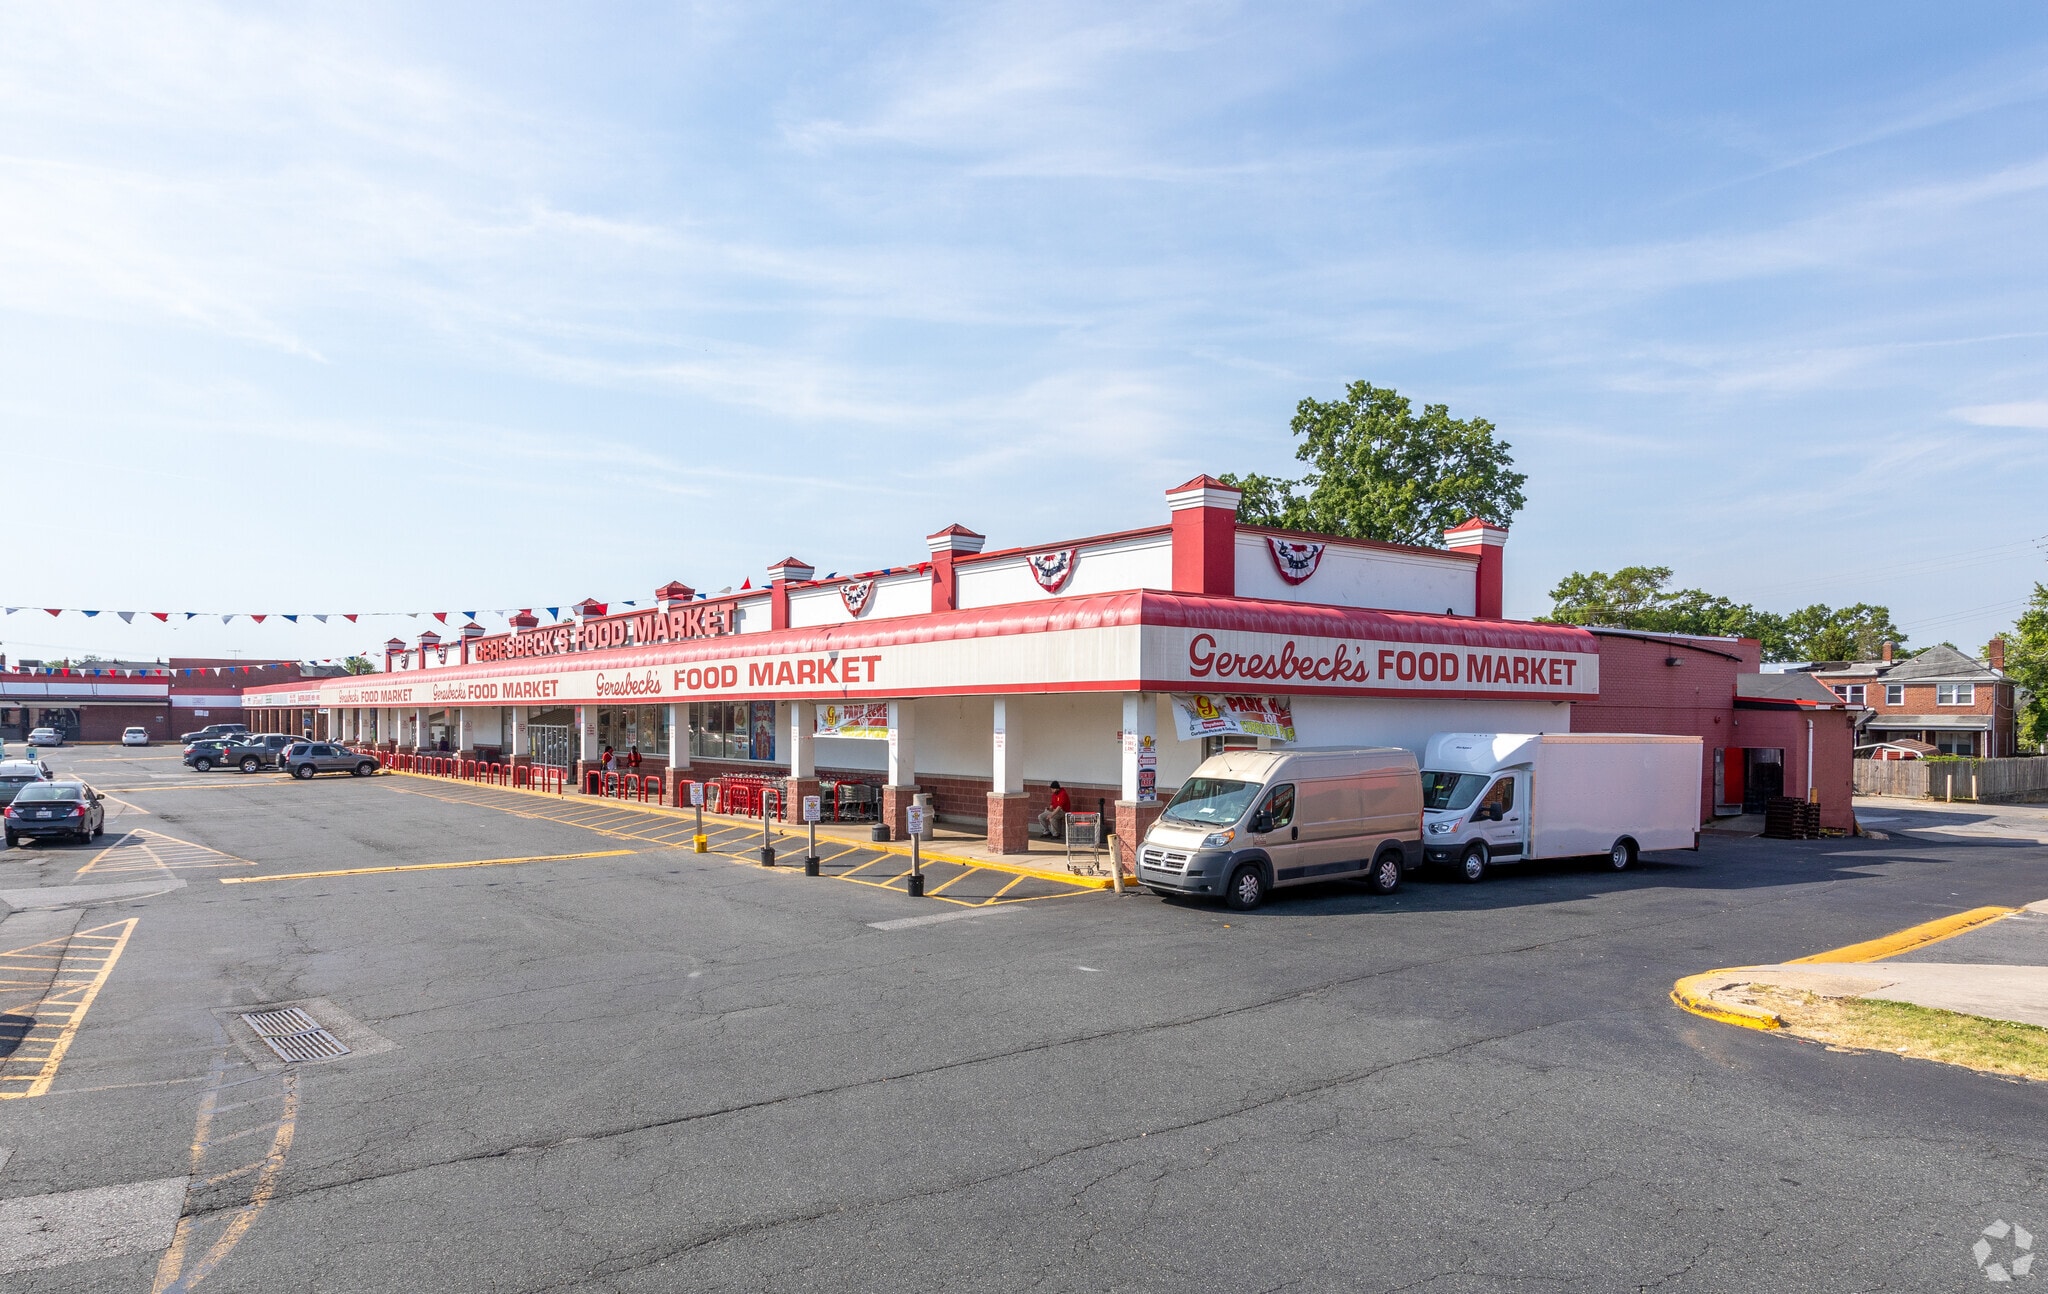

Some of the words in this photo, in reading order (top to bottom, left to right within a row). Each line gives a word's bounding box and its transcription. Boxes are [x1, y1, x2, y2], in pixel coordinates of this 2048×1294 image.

[476, 628, 569, 661] GERESBECK'S
[575, 620, 626, 651] FOOD
[633, 602, 737, 642] MARKET
[1189, 633, 1369, 683] Geresbeck's
[1378, 650, 1458, 681] FOOD
[1467, 654, 1576, 685] MARKET
[596, 672, 662, 696] Geresbeck's
[674, 665, 738, 690] FOOD
[749, 655, 882, 686] MARKET
[361, 690, 378, 702] FOOD
[381, 688, 413, 702] MARKET
[468, 683, 498, 699] FOOD
[502, 679, 559, 698] MARKET
[843, 704, 865, 719] PARK
[1226, 696, 1266, 713] PARK
[1263, 714, 1279, 724] FOR
